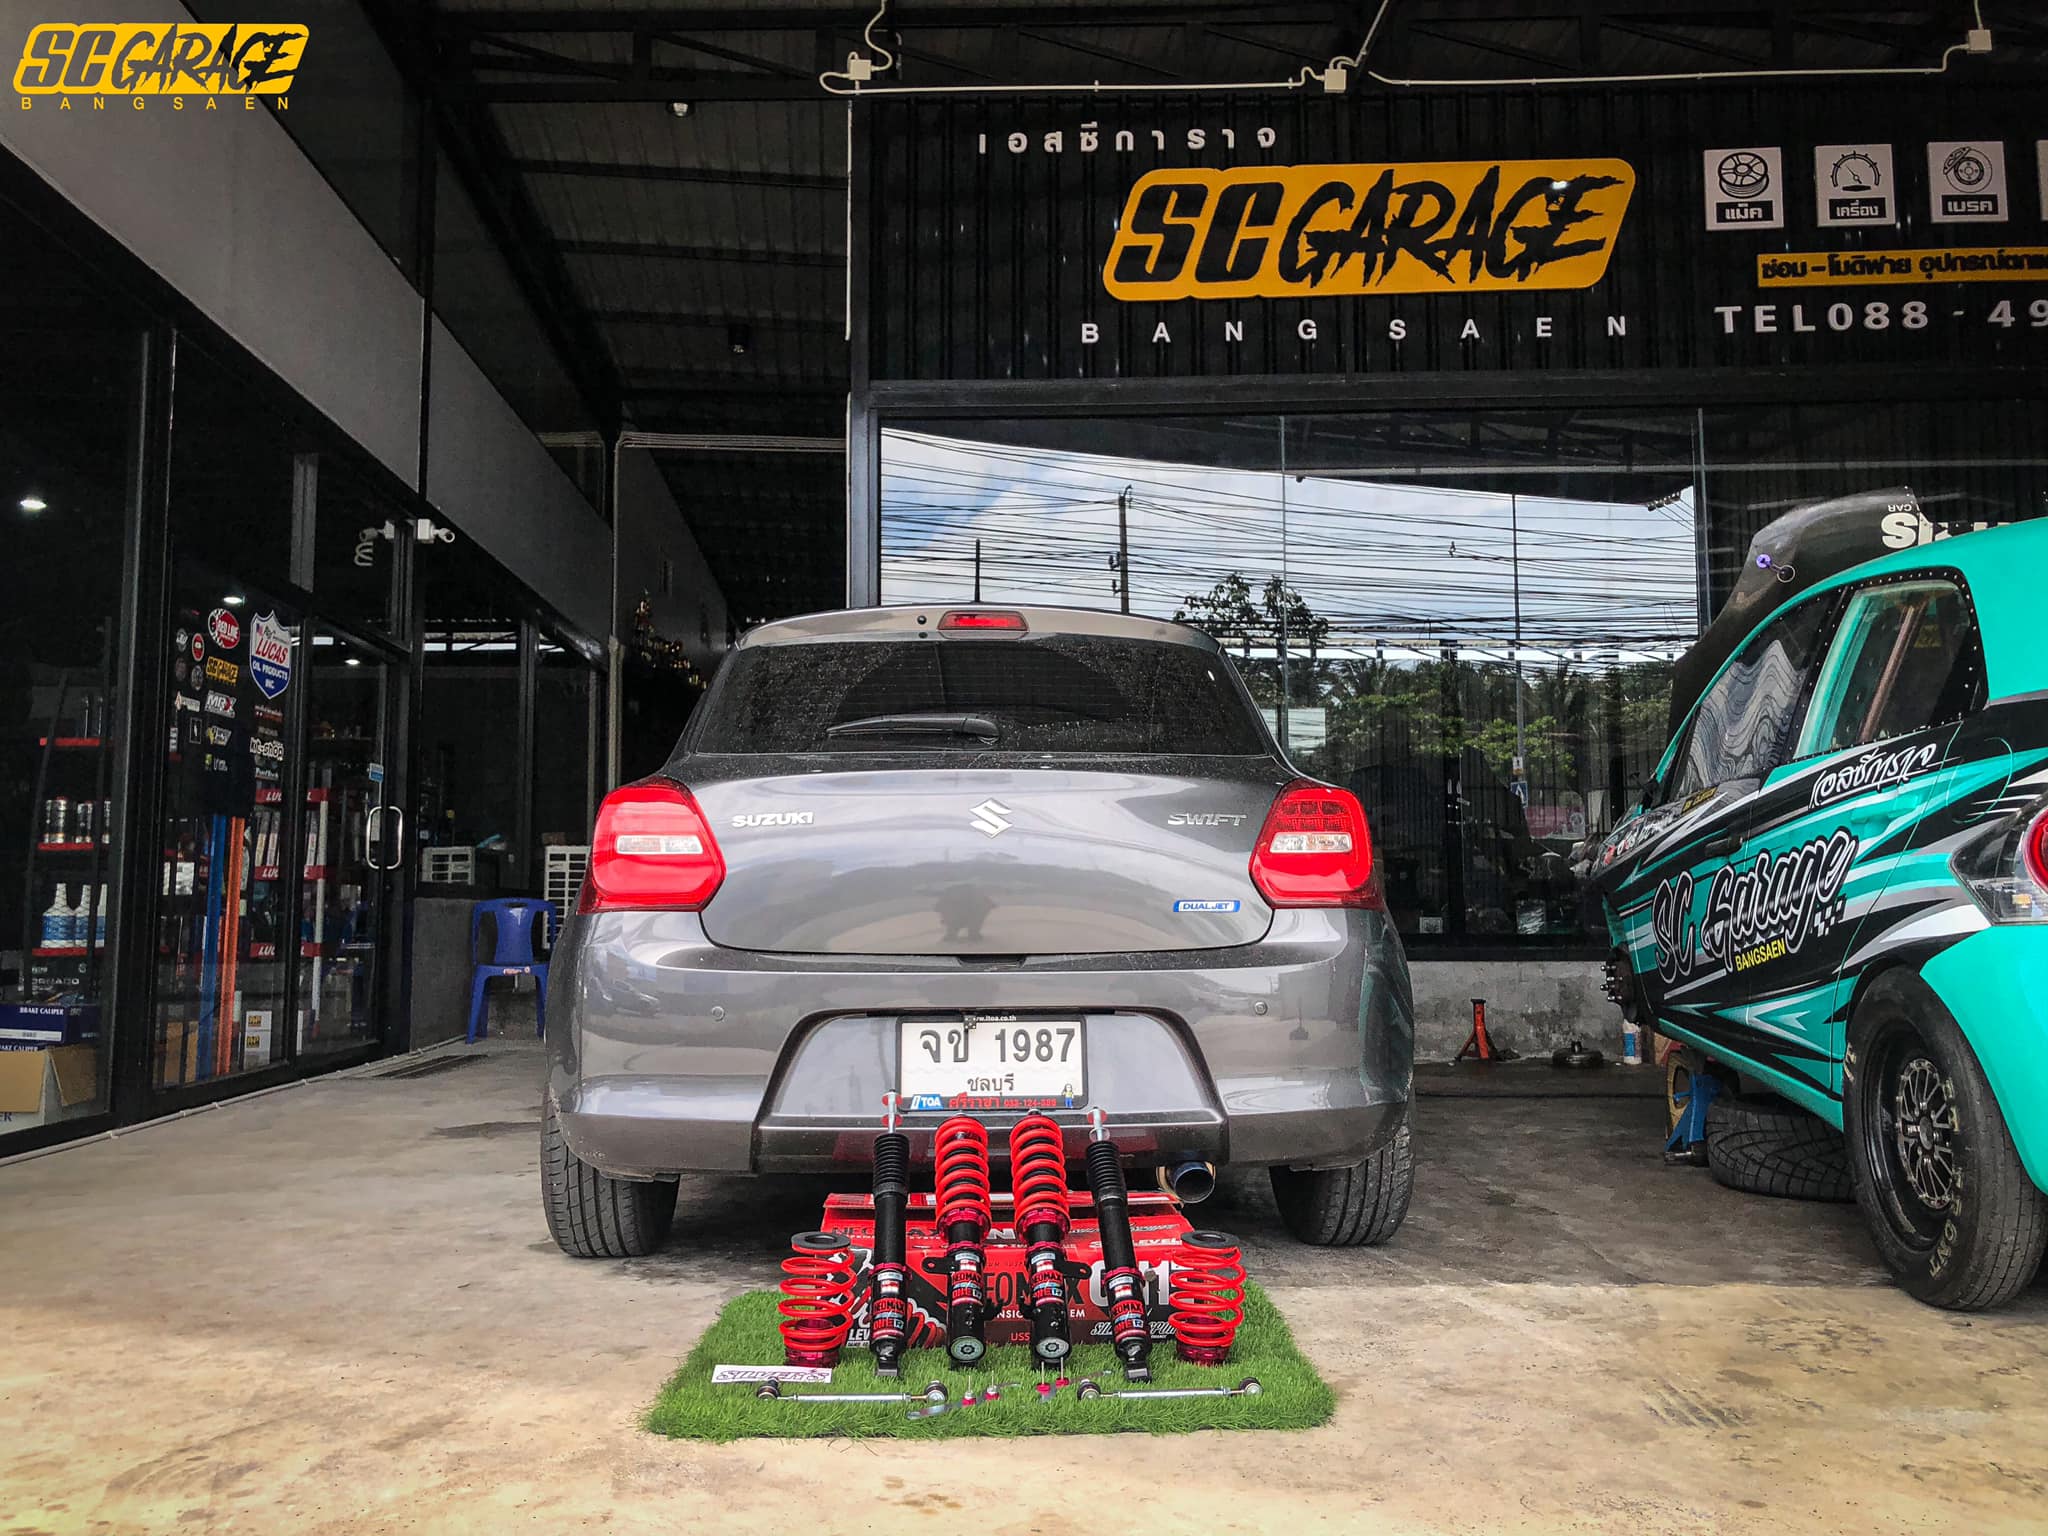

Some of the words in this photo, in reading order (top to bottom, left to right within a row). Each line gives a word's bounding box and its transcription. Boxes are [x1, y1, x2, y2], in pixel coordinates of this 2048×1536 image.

[979, 121, 1276, 154] เอสซีการาจ
[1114, 182, 1285, 283] SC
[1277, 165, 1626, 287] GARAGE
[1081, 315, 1627, 345] BANGSAEN
[255, 639, 288, 664] LUCAS
[262, 663, 288, 681] PRODUCTS
[731, 811, 814, 828] SUZUKI
[1167, 812, 1248, 826] SWIFT
[1653, 871, 1694, 984] SC
[1701, 830, 1857, 973] Garage
[1735, 937, 1786, 971] BANGSAEN
[19, 1006, 39, 1015] BRAKE
[40, 1007, 65, 1016] CALIPER
[920, 1028, 970, 1063] จข
[995, 1028, 1075, 1062] 1987
[967, 1073, 1014, 1096] ชลบุรี
